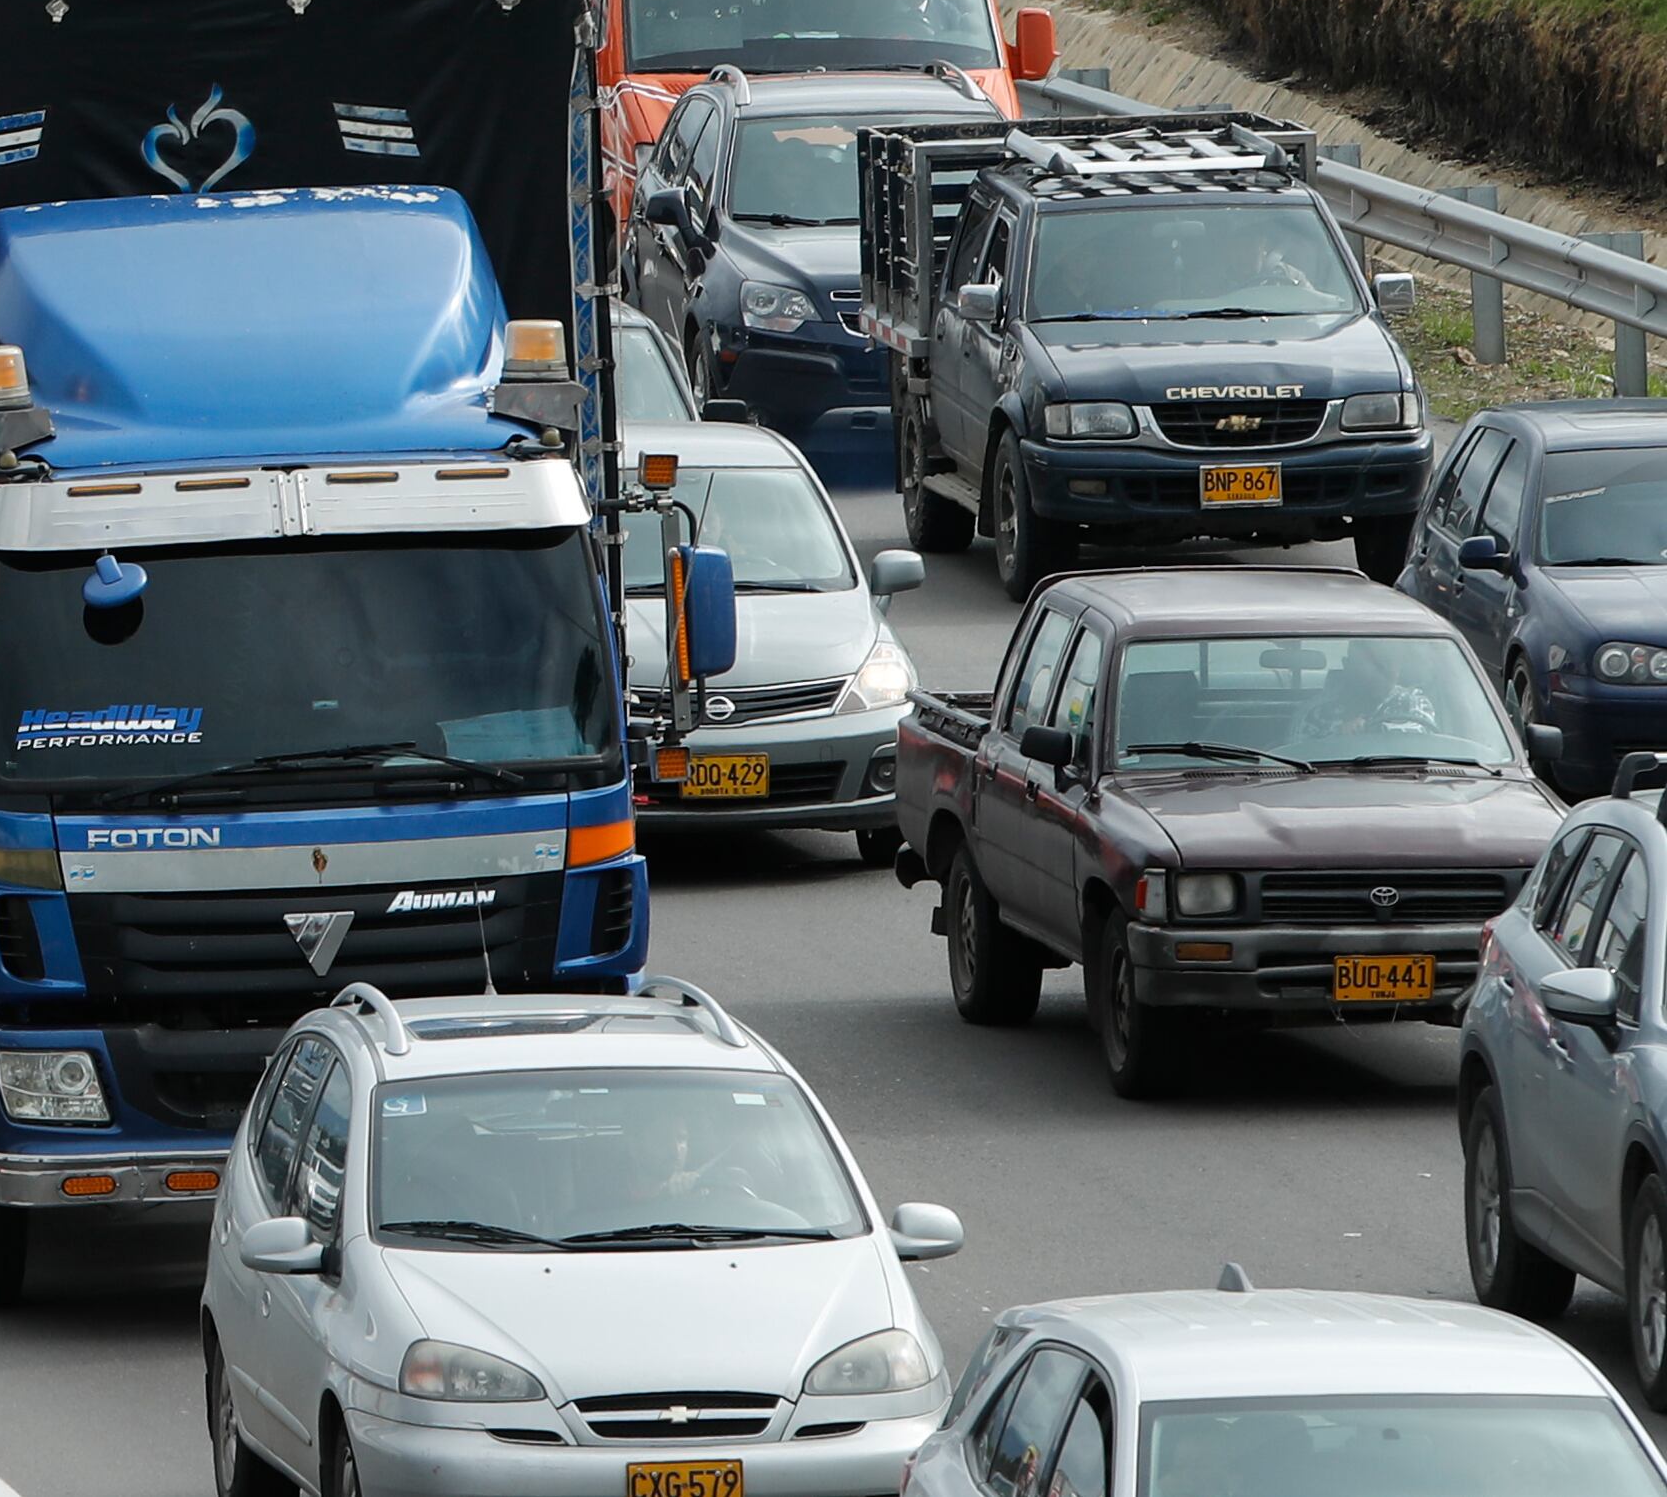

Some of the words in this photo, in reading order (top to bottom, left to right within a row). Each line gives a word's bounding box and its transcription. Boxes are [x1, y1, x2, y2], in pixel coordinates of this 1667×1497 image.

[1165, 384, 1305, 401] CHEVROLET
[16, 732, 204, 751] PERFORMANCE
[87, 827, 221, 850] FOTON
